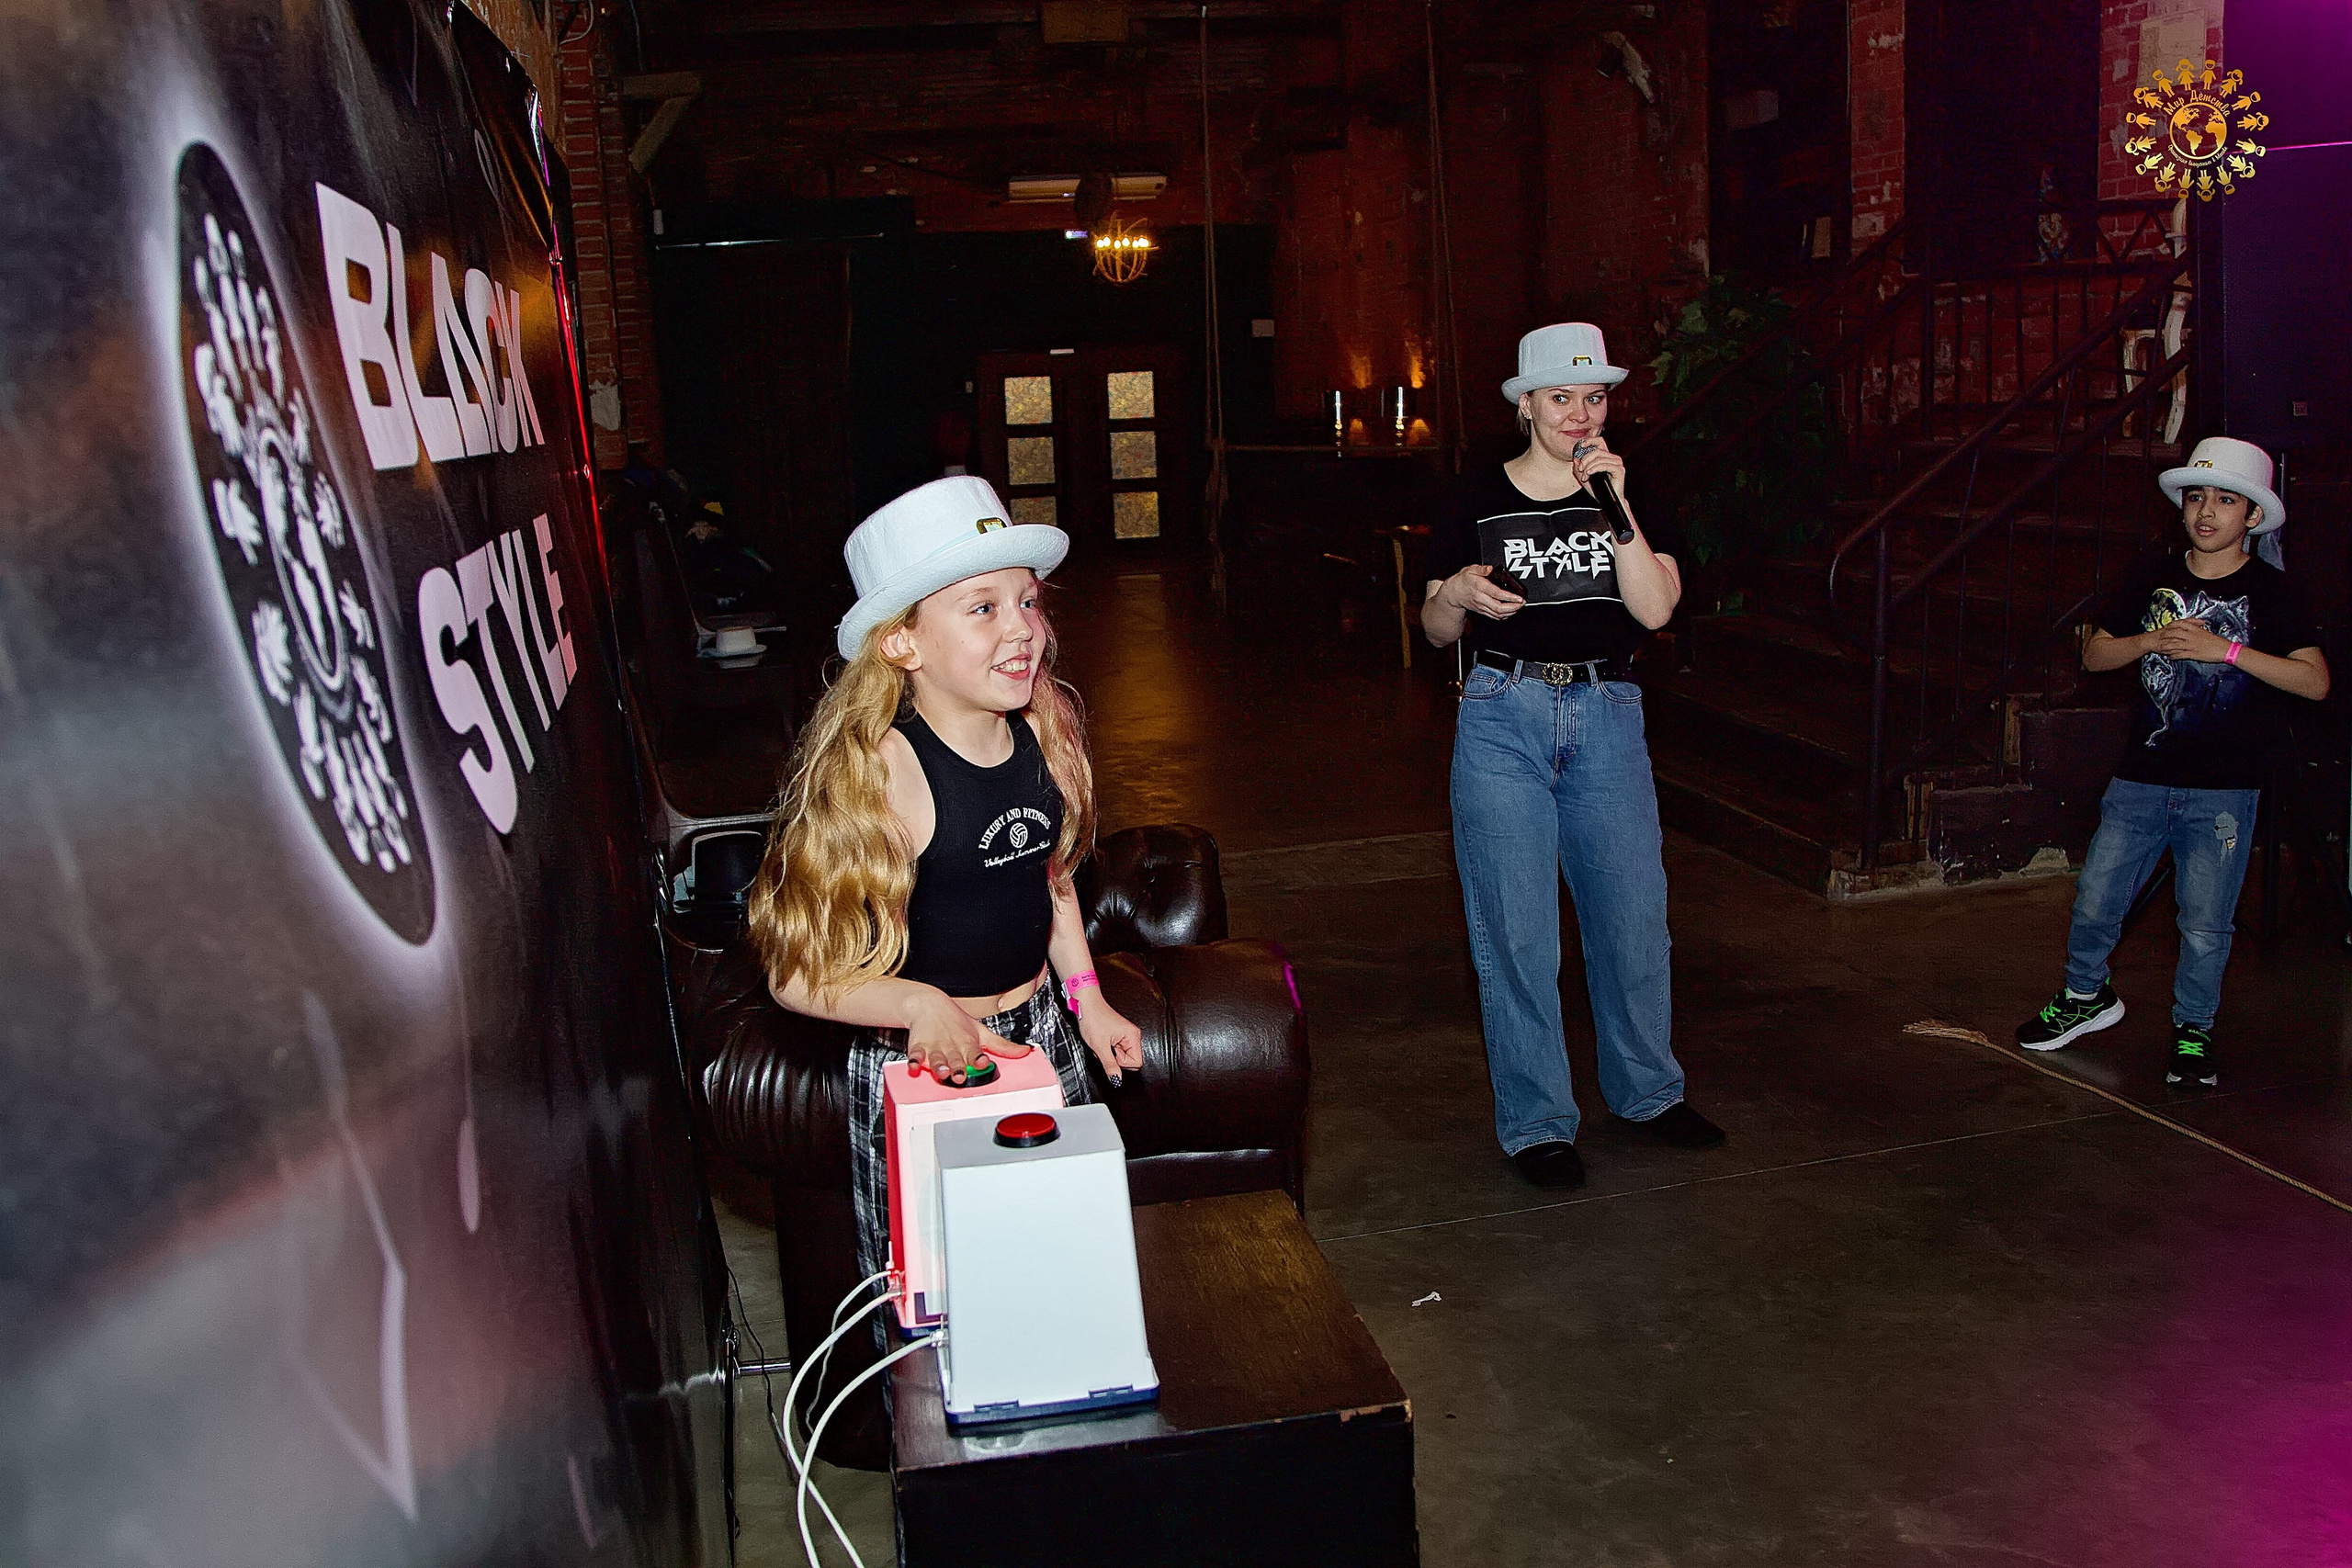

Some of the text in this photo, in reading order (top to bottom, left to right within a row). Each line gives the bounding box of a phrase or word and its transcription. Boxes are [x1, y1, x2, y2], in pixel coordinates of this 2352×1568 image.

[315, 182, 546, 471] BLACK
[1503, 530, 1615, 569] BLACK
[1509, 550, 1611, 580] STYLE
[418, 513, 577, 835] STYLE
[978, 807, 1051, 850] LUXURY AND FITNESS
